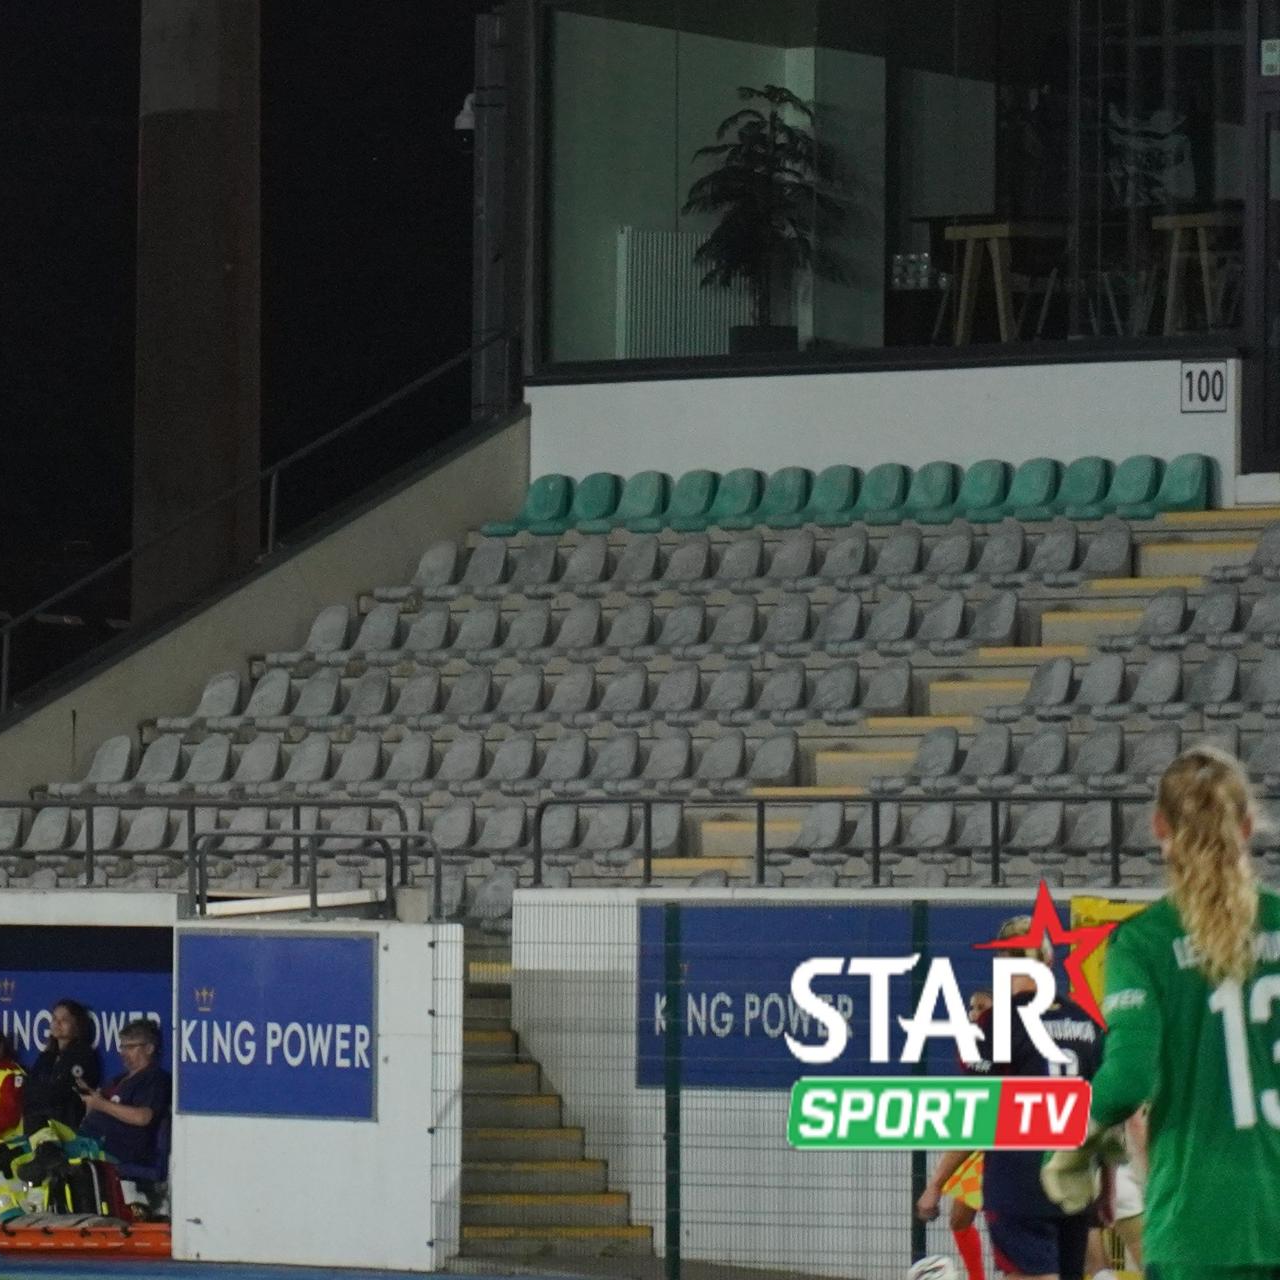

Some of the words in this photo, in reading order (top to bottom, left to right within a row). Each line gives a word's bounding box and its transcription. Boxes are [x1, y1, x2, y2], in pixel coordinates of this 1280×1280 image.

[1184, 369, 1224, 403] 100
[655, 992, 734, 1038] KNG
[181, 1019, 257, 1067] KING
[265, 1021, 370, 1070] POWER
[1208, 973, 1280, 1130] 13
